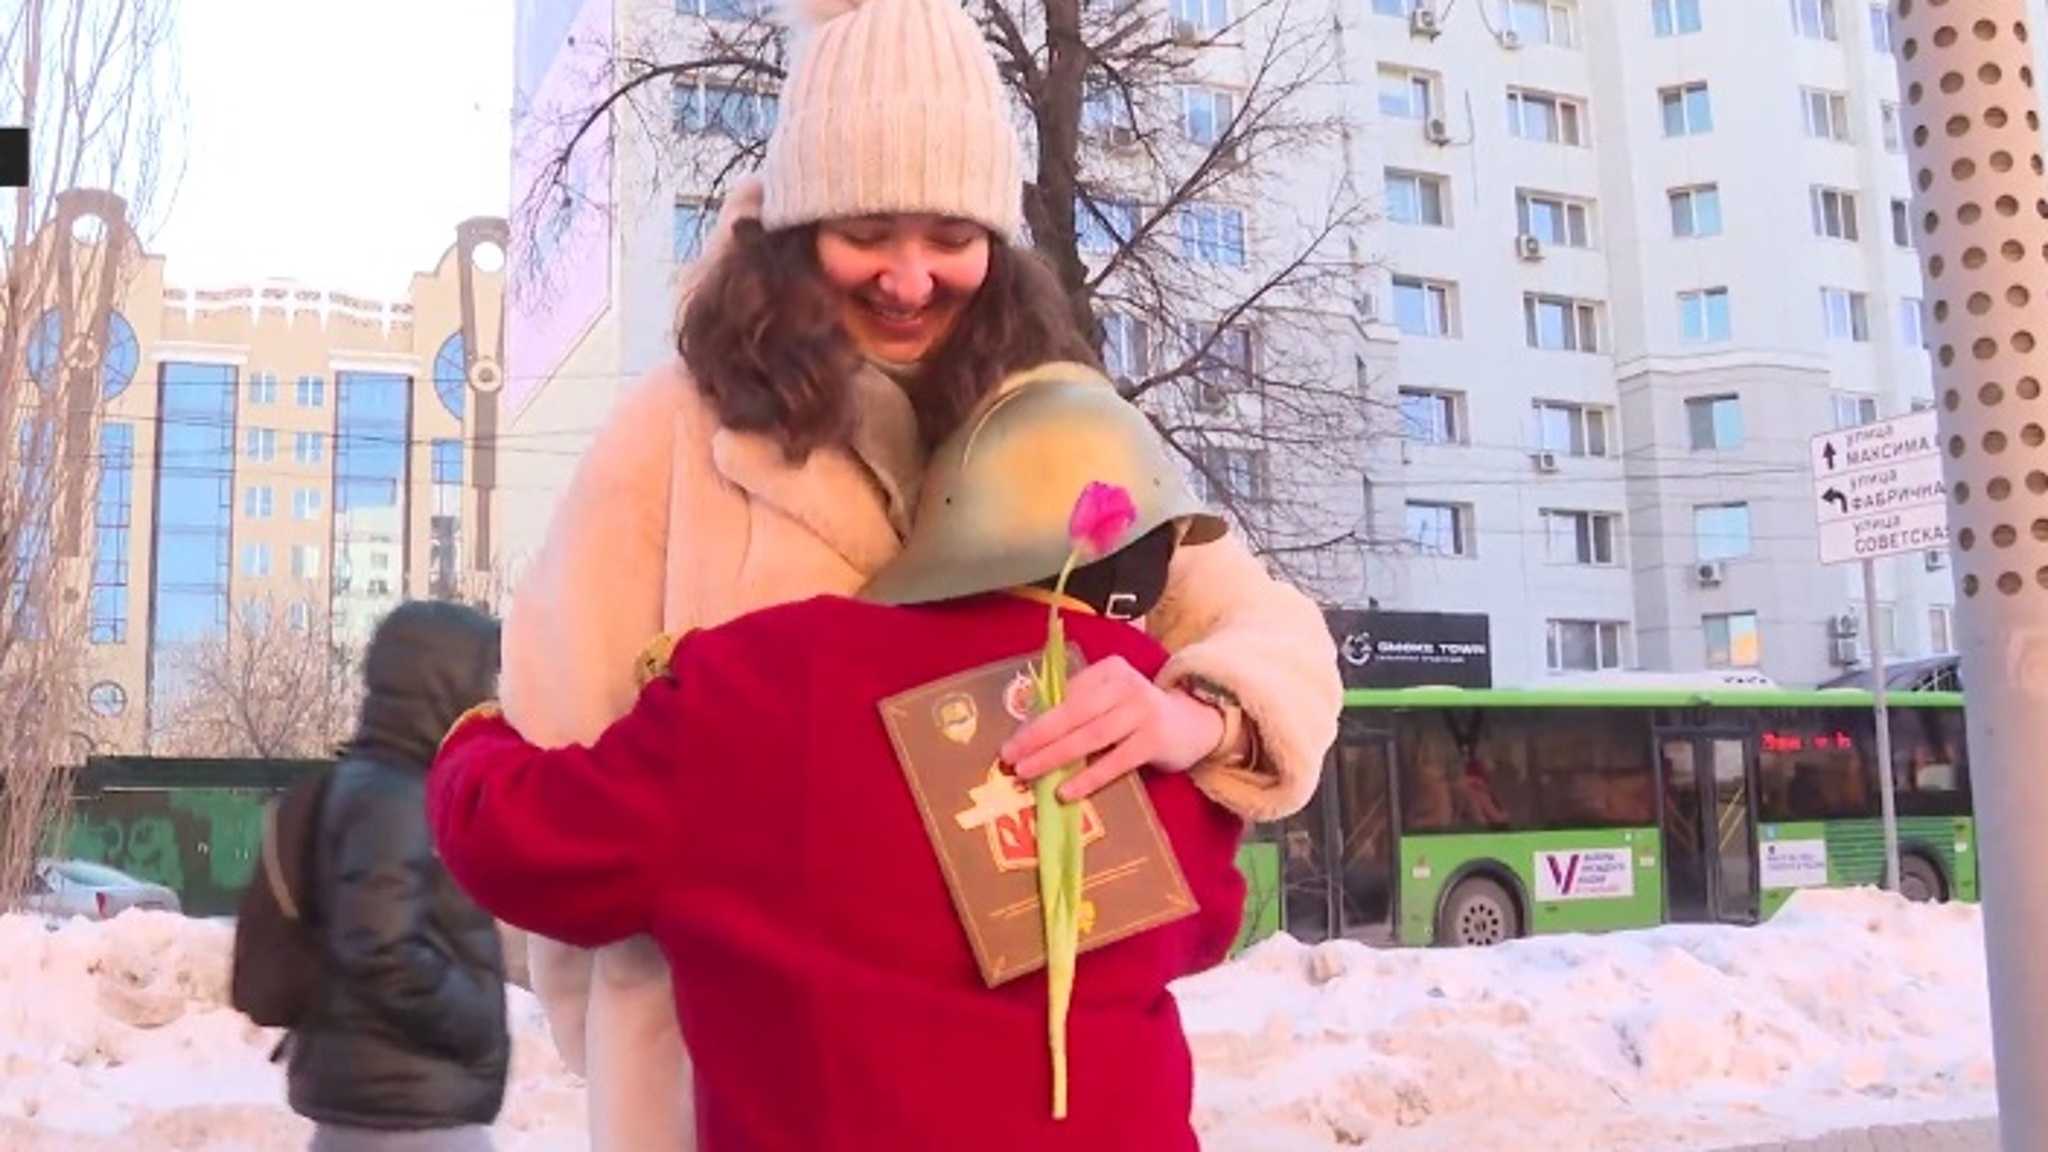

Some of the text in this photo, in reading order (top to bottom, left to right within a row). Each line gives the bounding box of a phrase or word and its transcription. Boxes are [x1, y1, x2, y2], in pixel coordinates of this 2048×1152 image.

[1846, 437, 1930, 464] МАКСИМА
[1850, 470, 1898, 491] улица
[1852, 480, 1947, 510] ФАБРИЧНА
[1853, 516, 1901, 536] улица
[1438, 643, 1486, 655] TOWN
